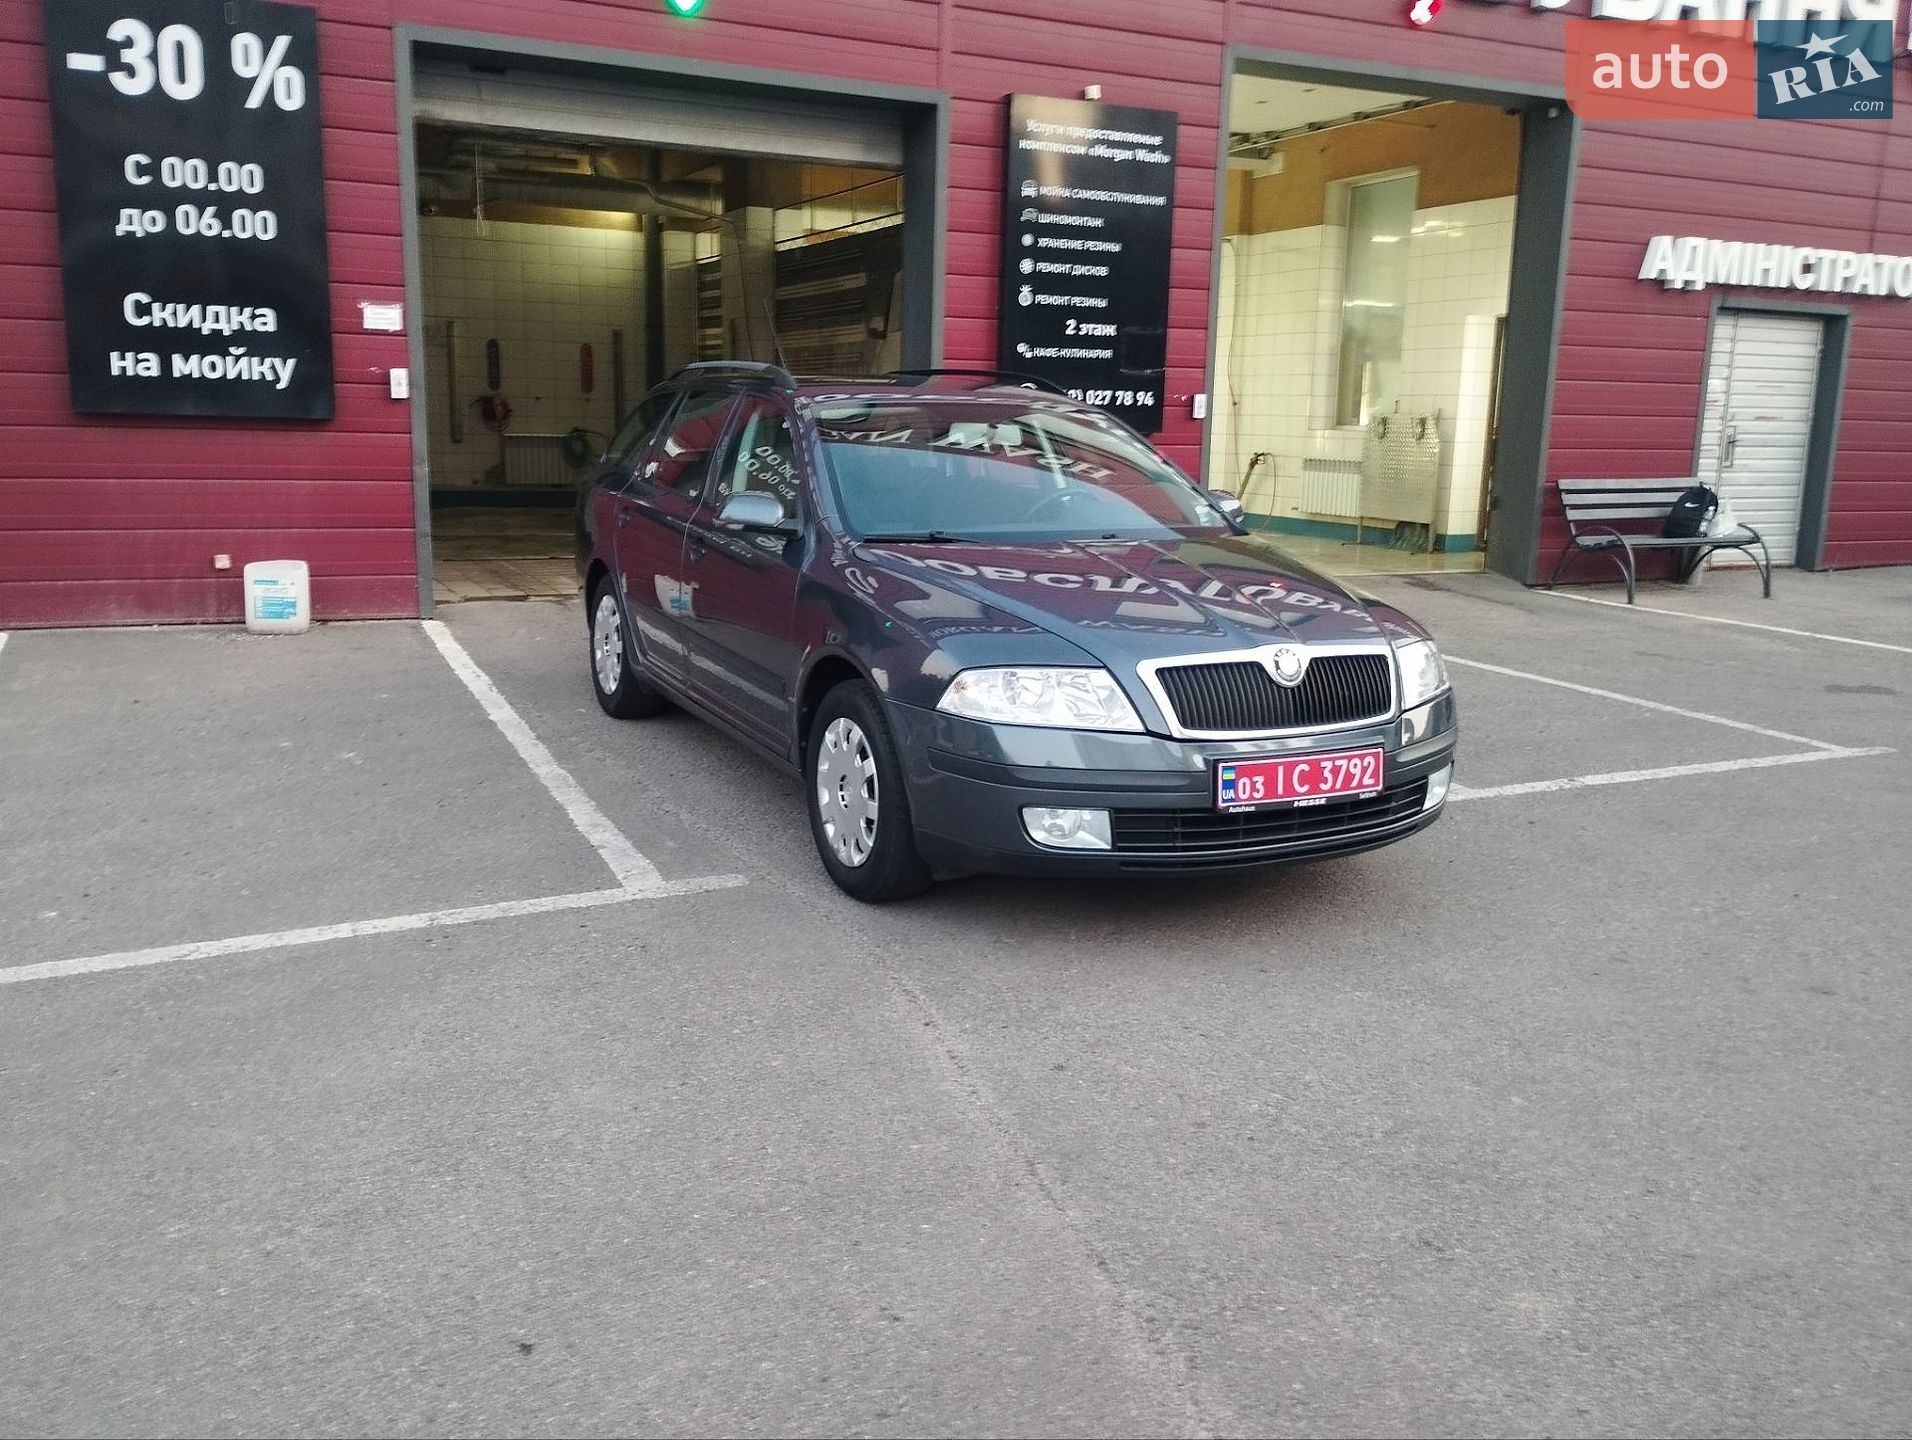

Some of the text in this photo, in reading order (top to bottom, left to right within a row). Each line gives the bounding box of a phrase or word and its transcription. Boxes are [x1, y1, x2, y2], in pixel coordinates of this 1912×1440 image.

[66, 18, 306, 111] -30 %
[124, 153, 265, 194] С 00.00
[115, 203, 278, 241] до 06.00
[1036, 262, 1109, 277] РЕМОНТ ДИСКОВ
[123, 292, 278, 335] Скидка
[1034, 294, 1109, 308] РЕМОНТ РЕЗИНЫ
[1065, 318, 1118, 337] 2 этаж
[109, 346, 297, 389] на мойку
[1085, 390, 1113, 406] 027
[1115, 390, 1134, 406] 78
[1222, 789, 1235, 800] UA
[1238, 776, 1265, 800] 03
[1319, 756, 1375, 790] 3792
